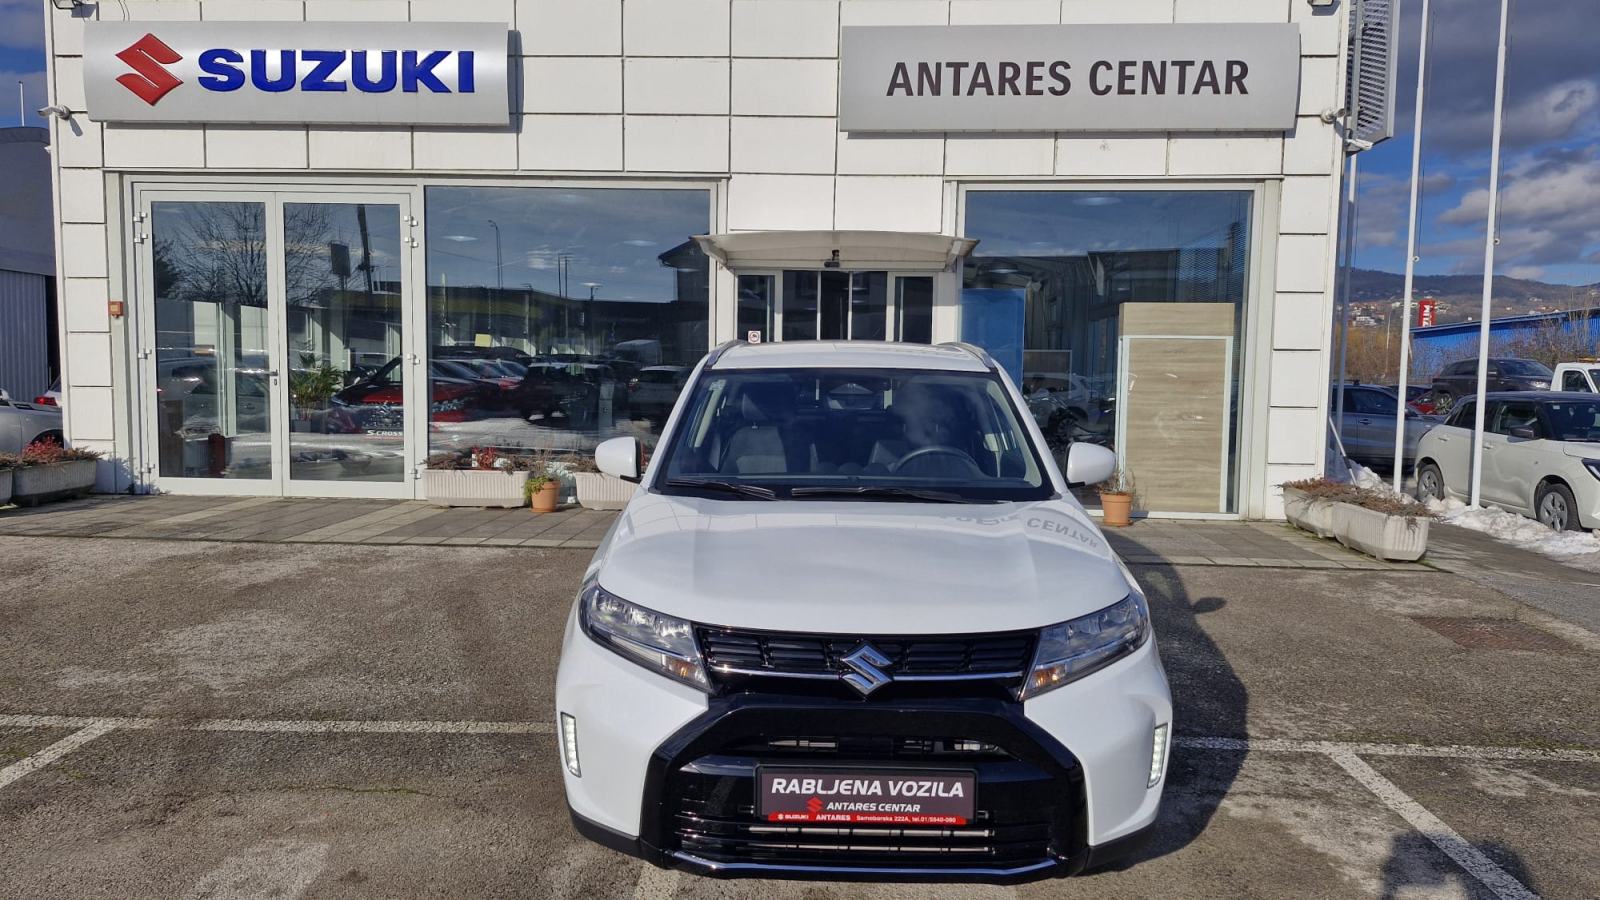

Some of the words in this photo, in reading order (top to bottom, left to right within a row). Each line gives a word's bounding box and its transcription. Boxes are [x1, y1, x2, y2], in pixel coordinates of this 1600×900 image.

[198, 48, 475, 93] SUZUKI
[886, 61, 1071, 97] ANTARES
[1088, 60, 1249, 95] CENTAR
[771, 778, 882, 796] RABLJENA
[888, 780, 964, 797] VOZILA
[826, 802, 876, 811] ANTARES
[878, 803, 921, 812] CENTAR
